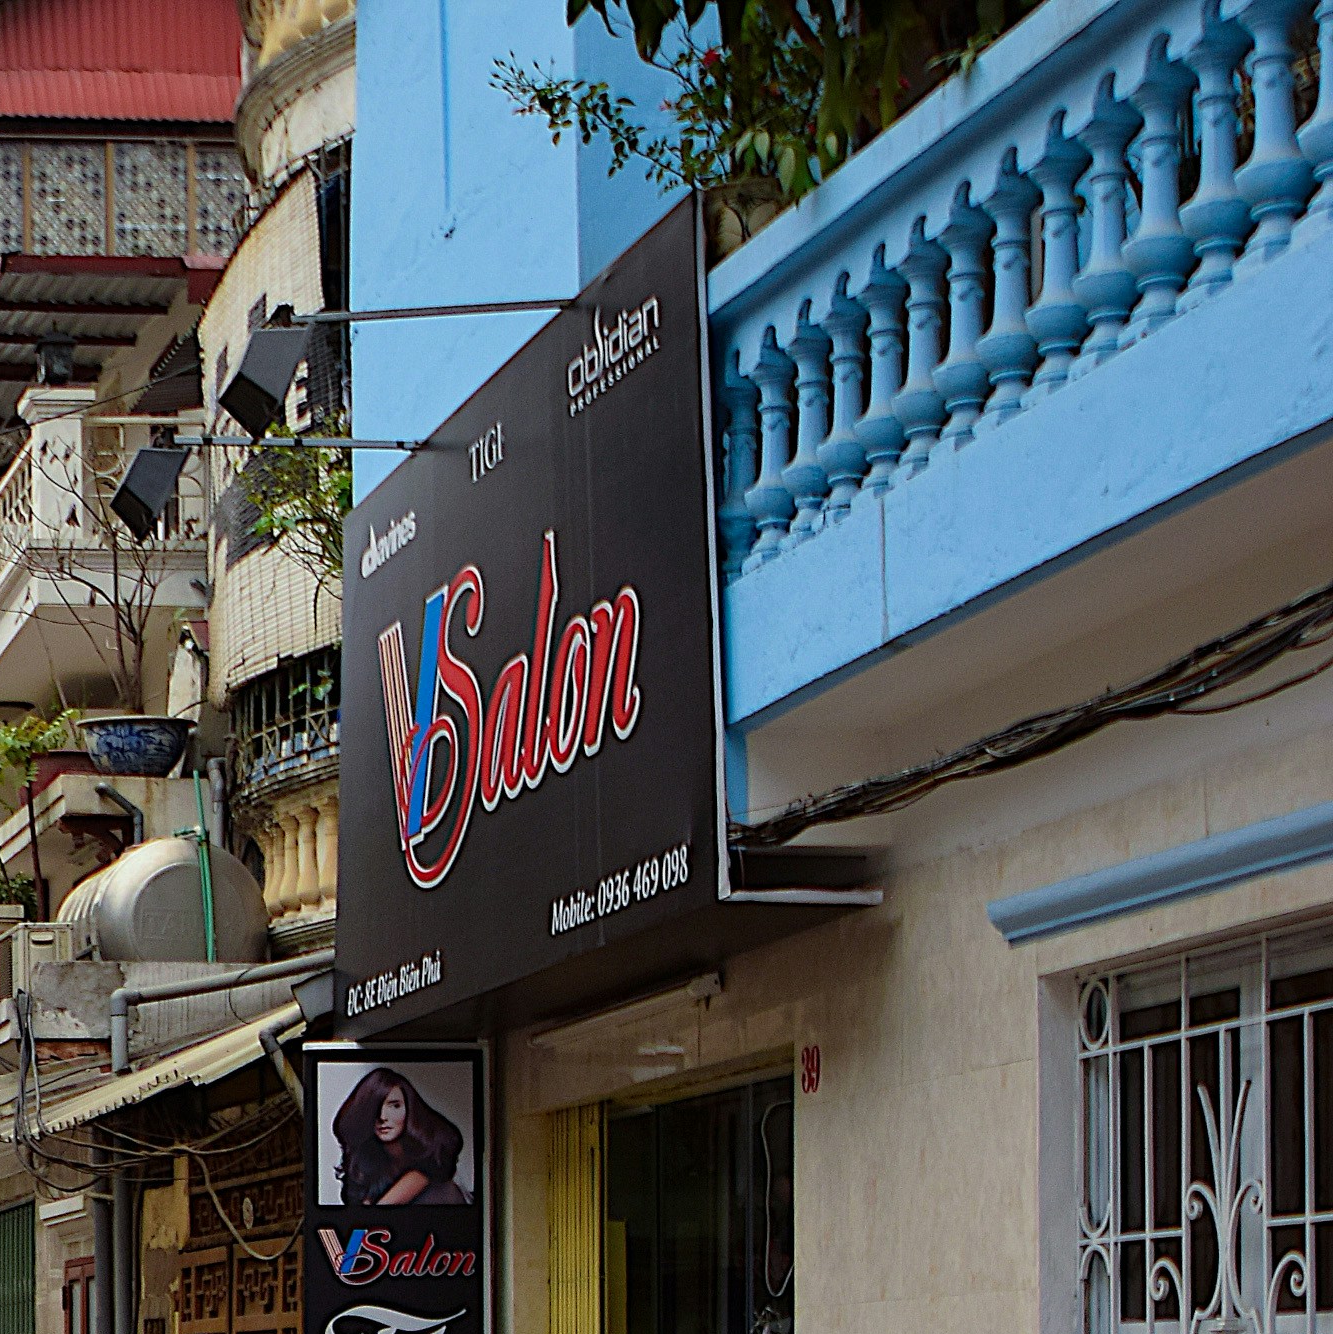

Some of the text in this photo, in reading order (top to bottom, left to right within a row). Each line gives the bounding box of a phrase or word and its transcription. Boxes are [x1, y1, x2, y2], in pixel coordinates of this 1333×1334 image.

[467, 421, 505, 483] TIGI
[361, 509, 417, 579] davines
[551, 844, 688, 935] Mobile: 0936 469 098
